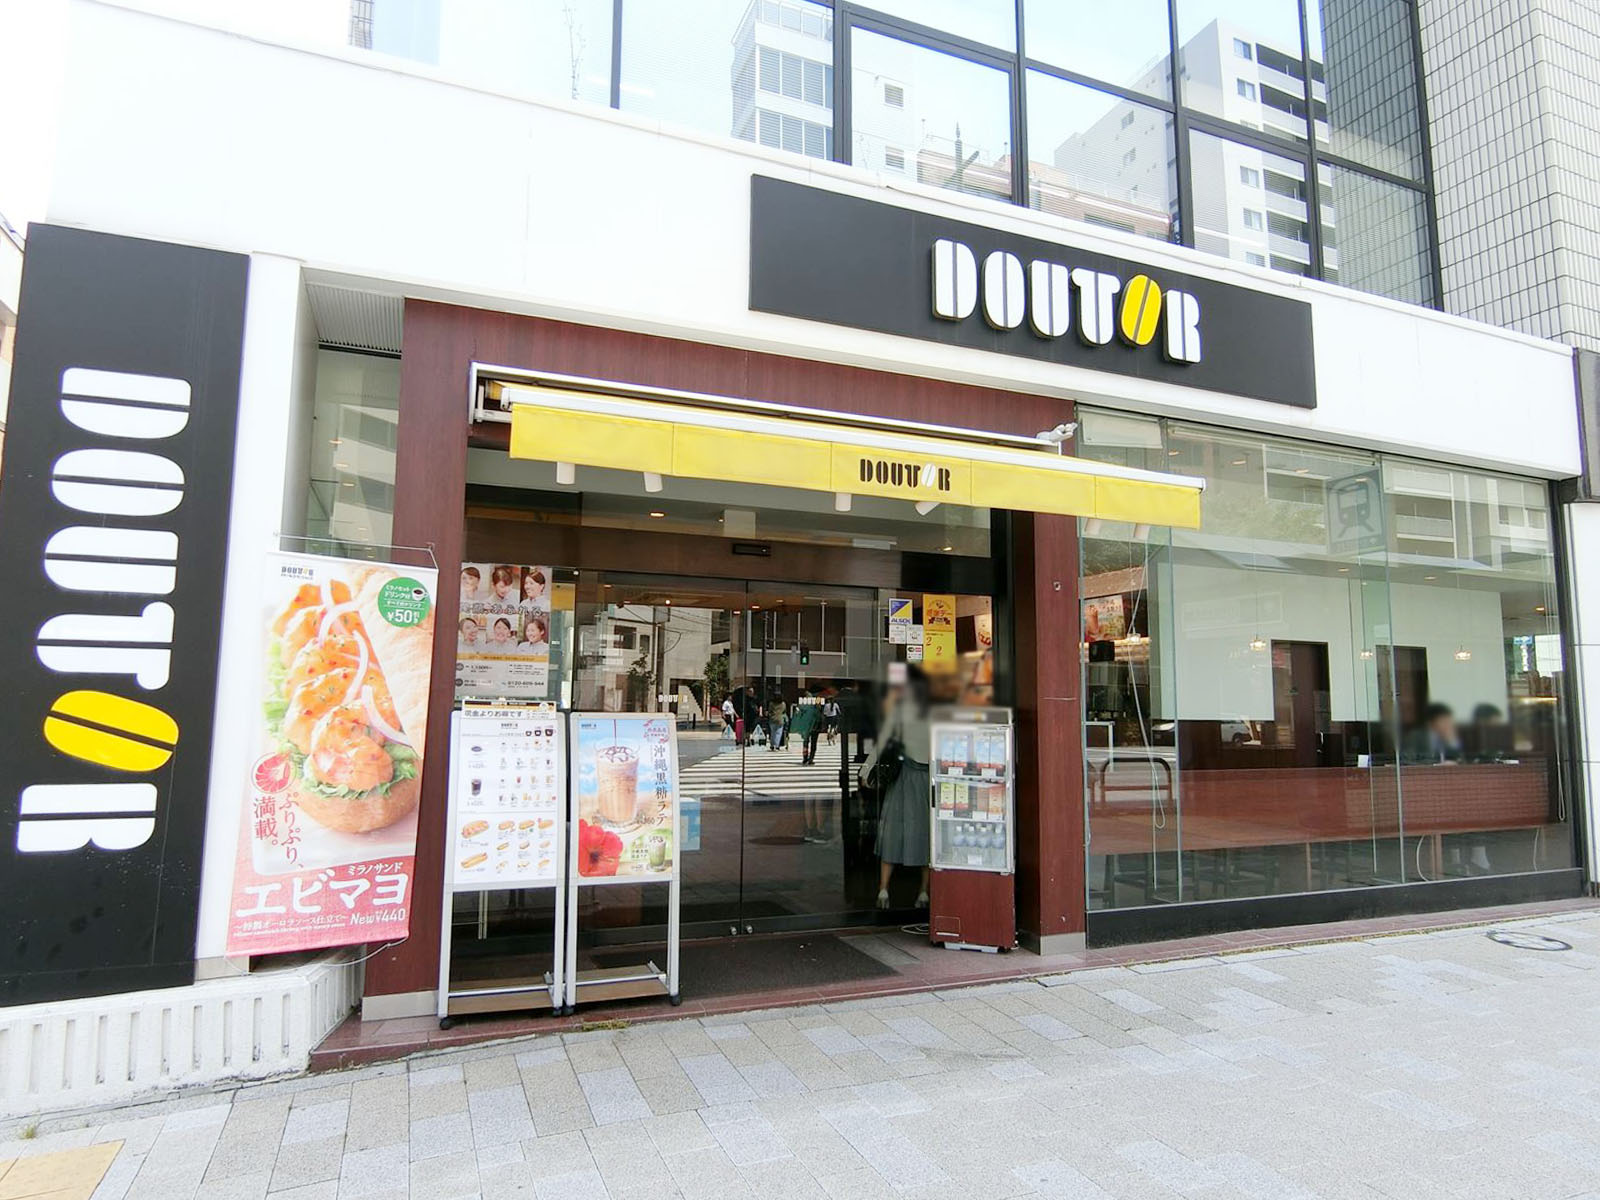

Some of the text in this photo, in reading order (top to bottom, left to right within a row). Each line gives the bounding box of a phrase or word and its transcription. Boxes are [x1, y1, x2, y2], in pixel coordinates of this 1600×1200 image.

[931, 238, 1203, 364] DOUTOR
[858, 458, 951, 492] DOUTOR
[16, 366, 192, 854] DOUTOR
[653, 744, 669, 827] 沖縄黒糖ラテ
[253, 796, 279, 847] 満載。
[279, 791, 305, 869] ぷりぷり、
[235, 868, 409, 918] エビマヨ
[347, 862, 404, 876] ミラノサンド
[350, 912, 374, 926] New
